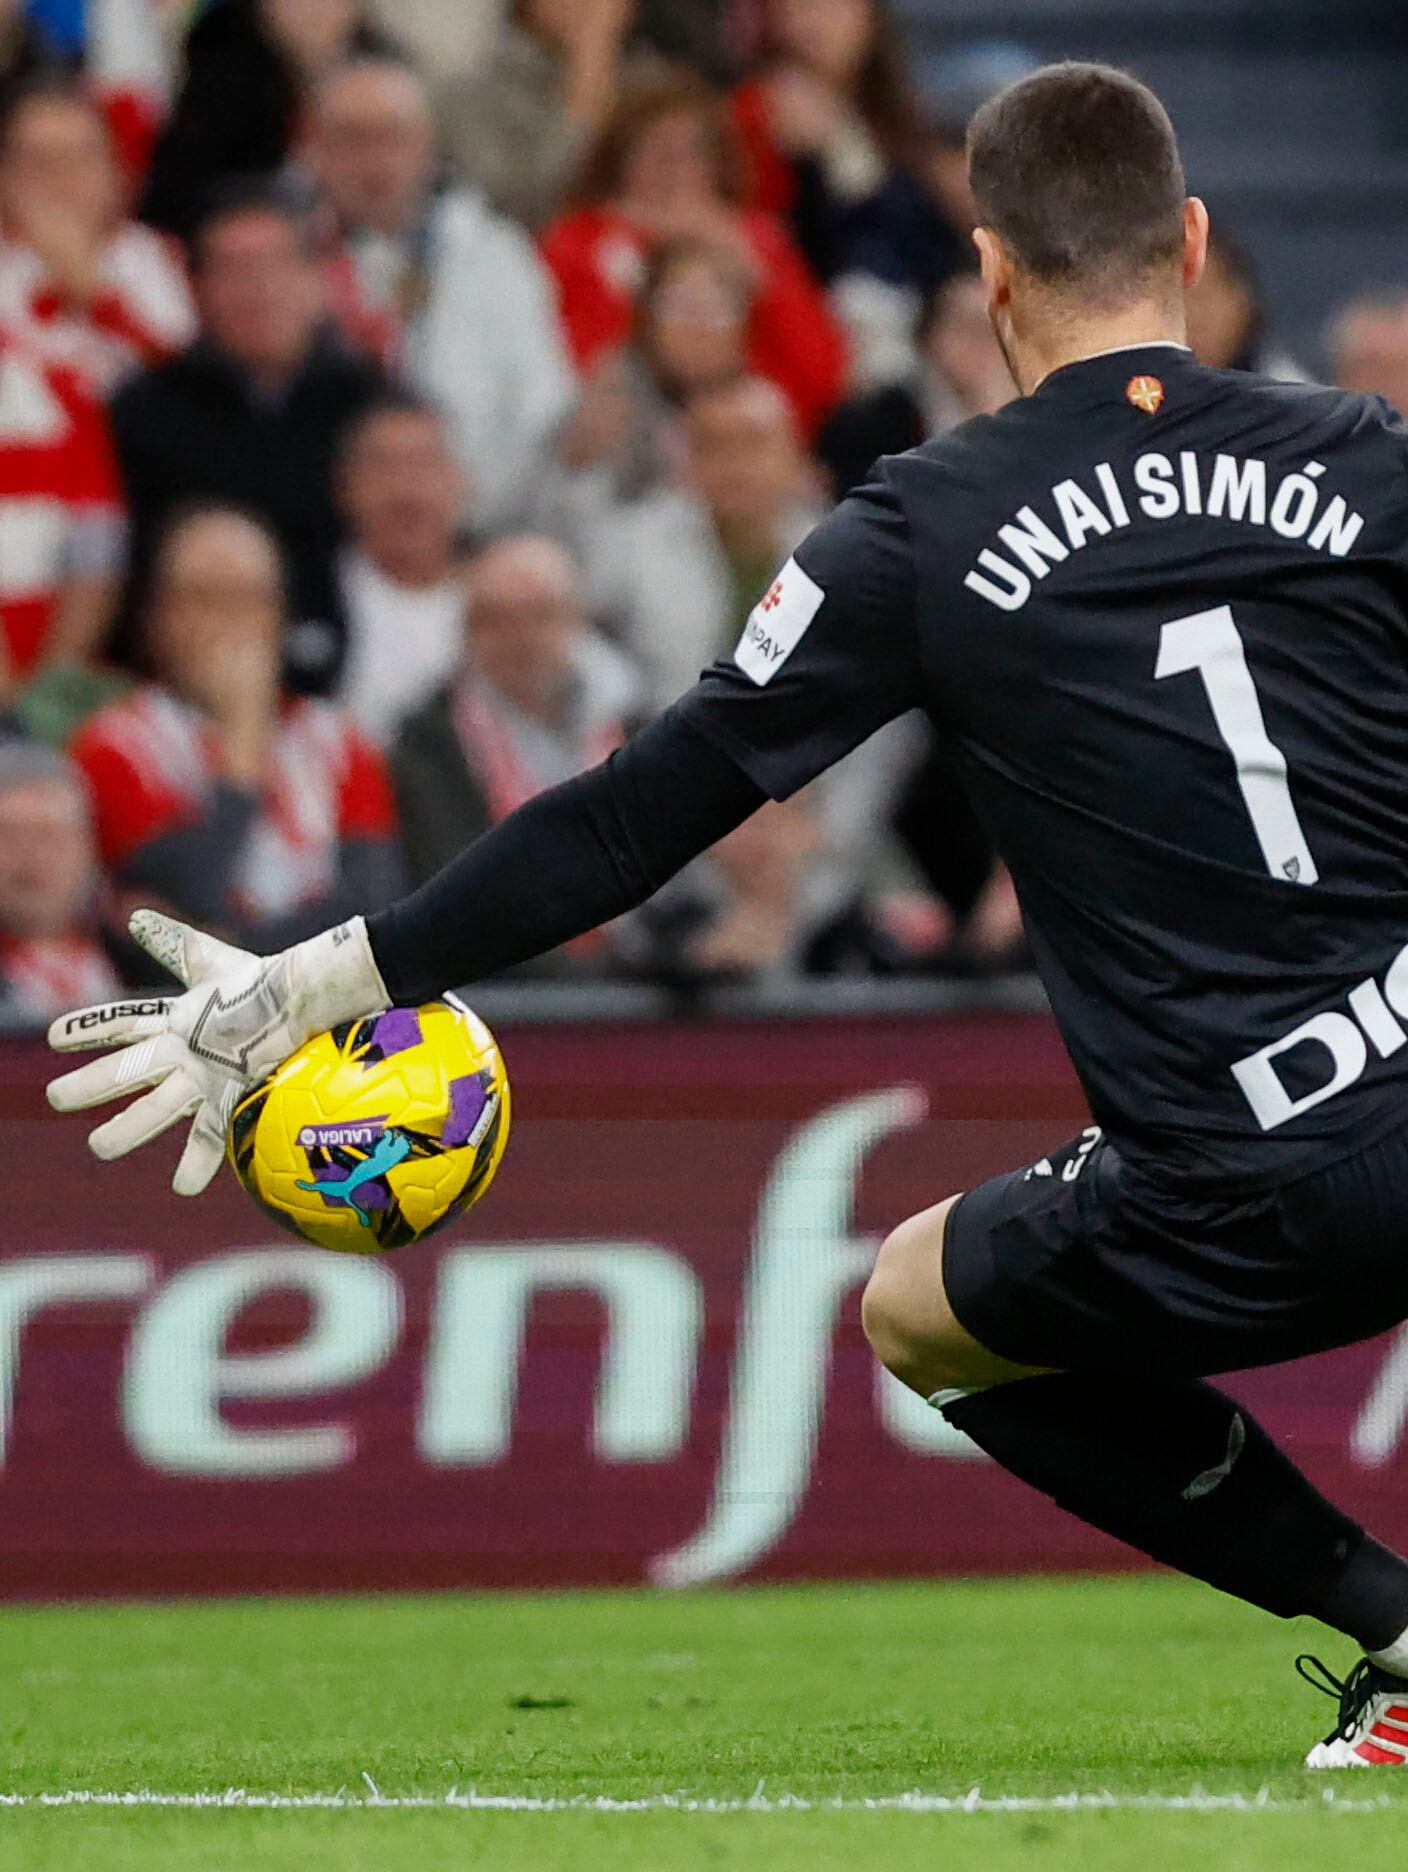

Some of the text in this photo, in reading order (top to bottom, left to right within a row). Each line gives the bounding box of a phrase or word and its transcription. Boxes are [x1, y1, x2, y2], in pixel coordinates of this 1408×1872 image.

[962, 451, 1365, 612] UNAI SIMÓN
[1155, 604, 1319, 885] 1
[65, 999, 171, 1036] reusch
[318, 1127, 372, 1145] LALIGA
[0, 1080, 1000, 1590] renf
